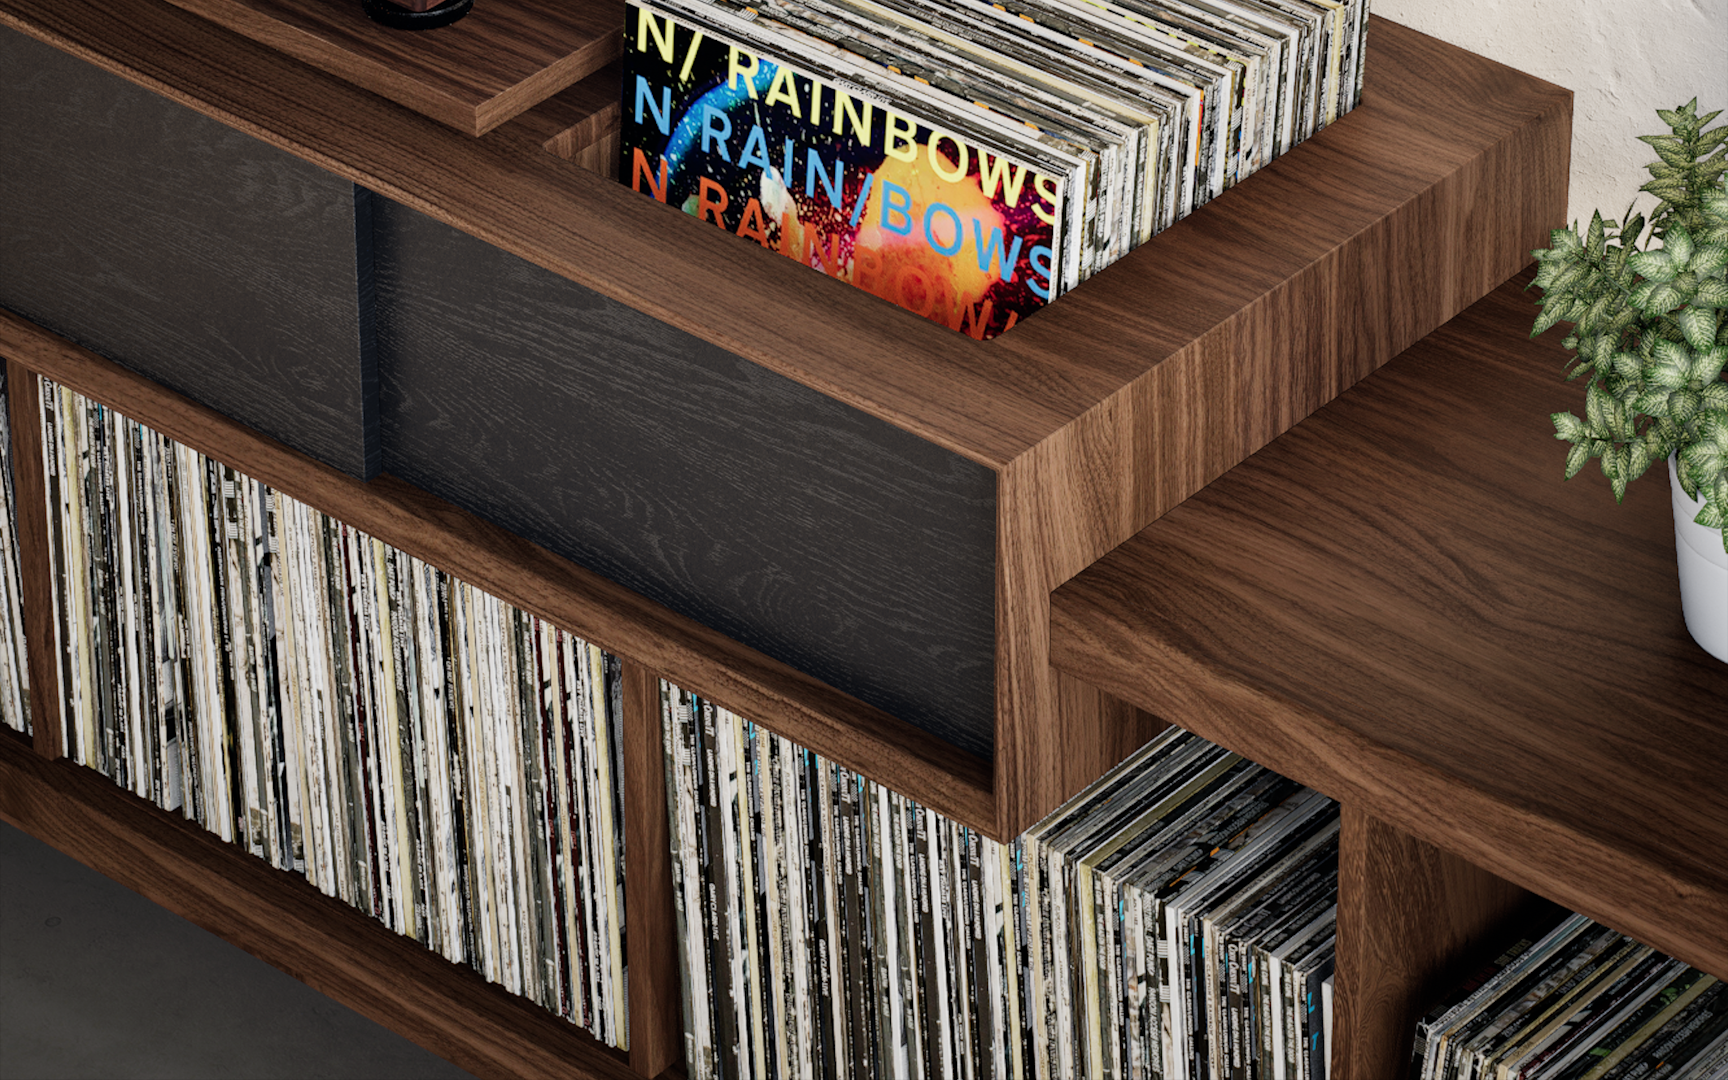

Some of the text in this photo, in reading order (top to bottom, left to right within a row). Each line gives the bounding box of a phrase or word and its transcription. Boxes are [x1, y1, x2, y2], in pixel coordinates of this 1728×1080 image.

[632, 147, 668, 204] N
[635, 74, 1054, 300] N RAIN/BOWS
[728, 46, 1059, 225] RAINBOWS
